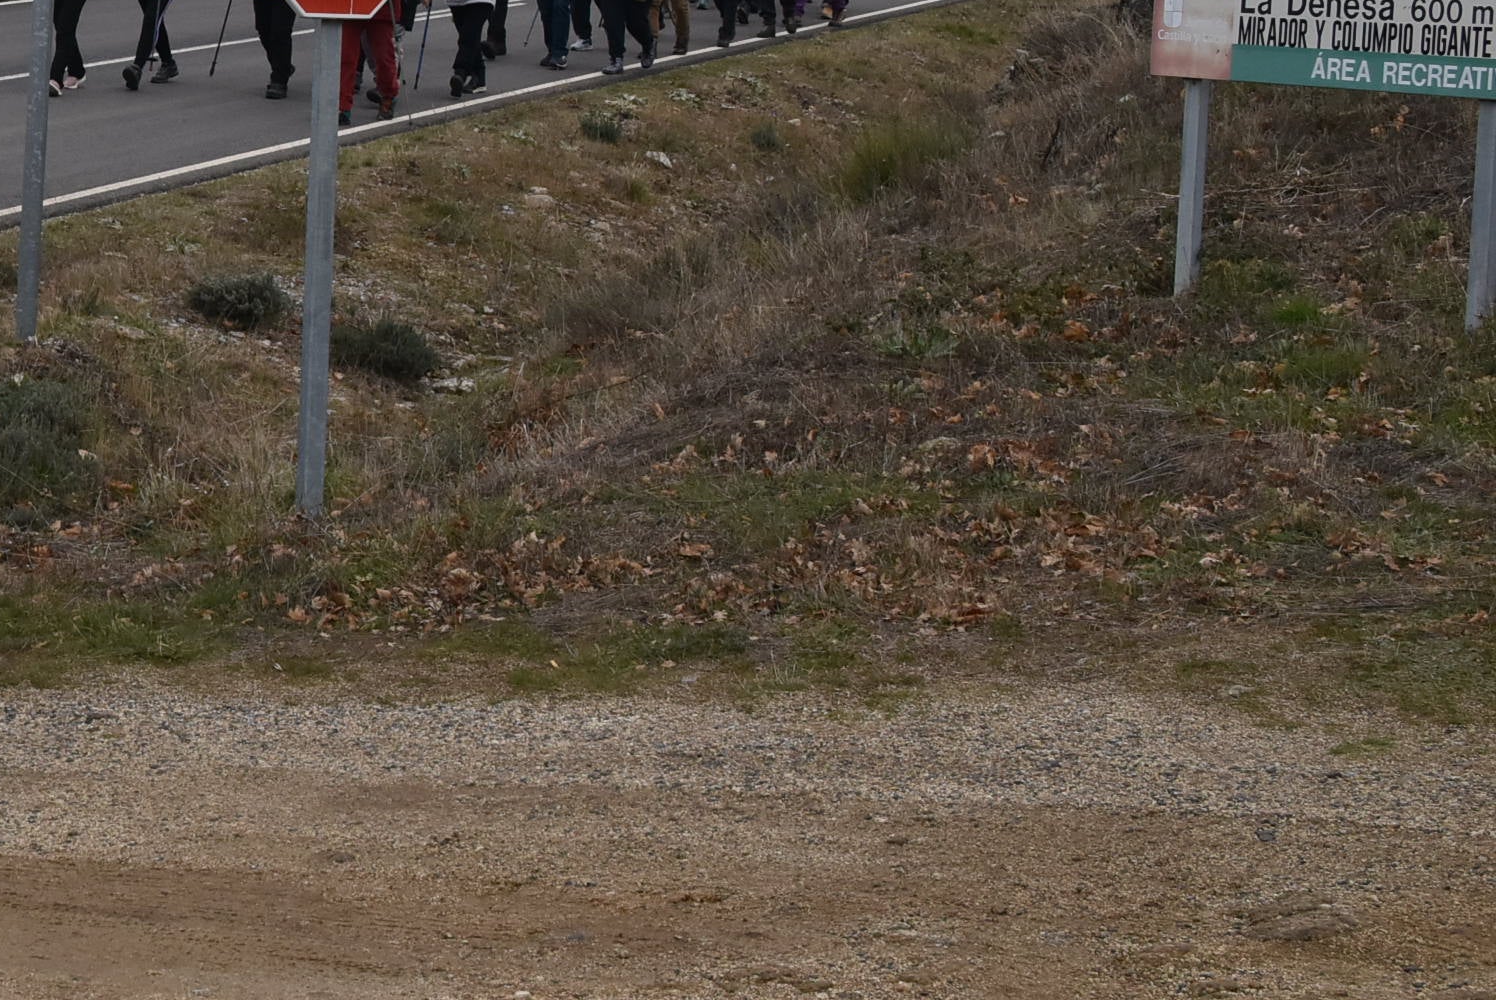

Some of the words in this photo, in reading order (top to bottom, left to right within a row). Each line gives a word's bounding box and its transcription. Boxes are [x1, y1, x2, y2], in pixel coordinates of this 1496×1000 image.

[1472, 6, 1494, 25] m
[1238, 16, 1308, 48] MIRADOR
[1316, 20, 1325, 49] Y
[1332, 20, 1413, 54] COLUMPIO
[1421, 24, 1493, 57] GIGANTE
[1311, 52, 1371, 83] ÁREA
[1382, 61, 1496, 91] RECREATI
